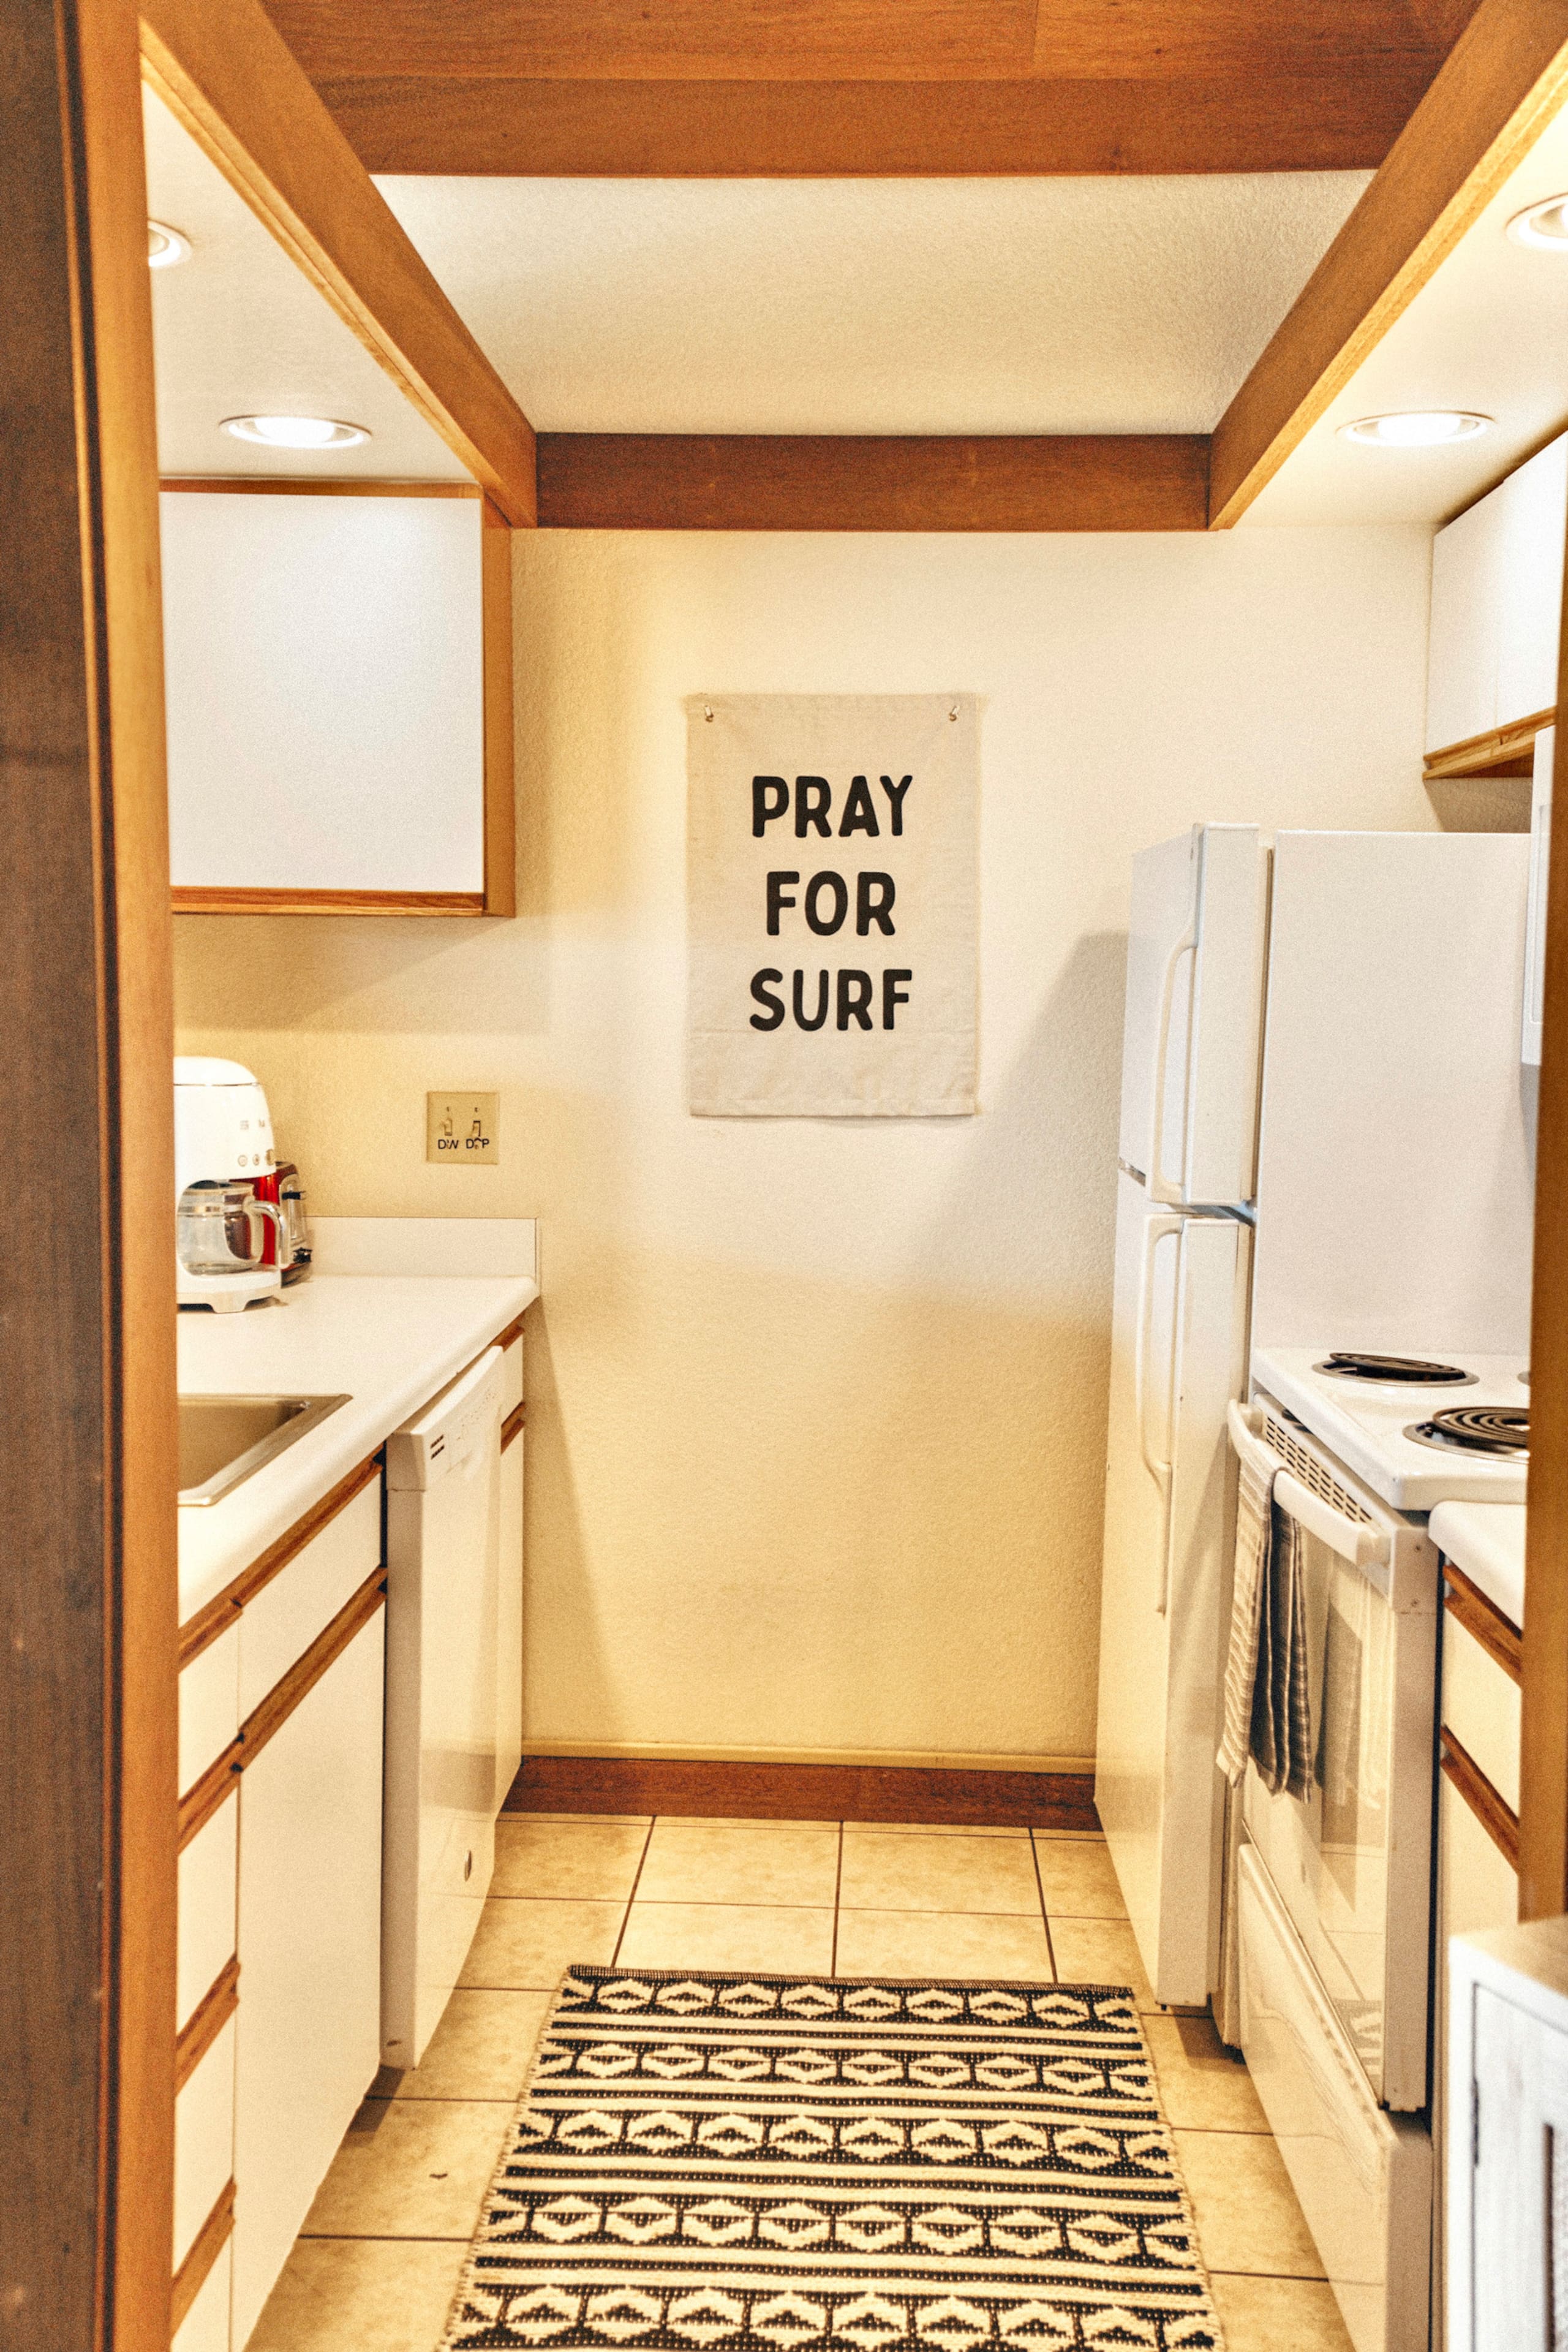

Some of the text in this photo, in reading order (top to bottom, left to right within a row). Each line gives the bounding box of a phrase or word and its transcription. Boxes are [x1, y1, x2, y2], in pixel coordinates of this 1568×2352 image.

[752, 775, 913, 838] PRAY
[766, 871, 895, 936] FOR
[749, 968, 913, 1032] SURF
